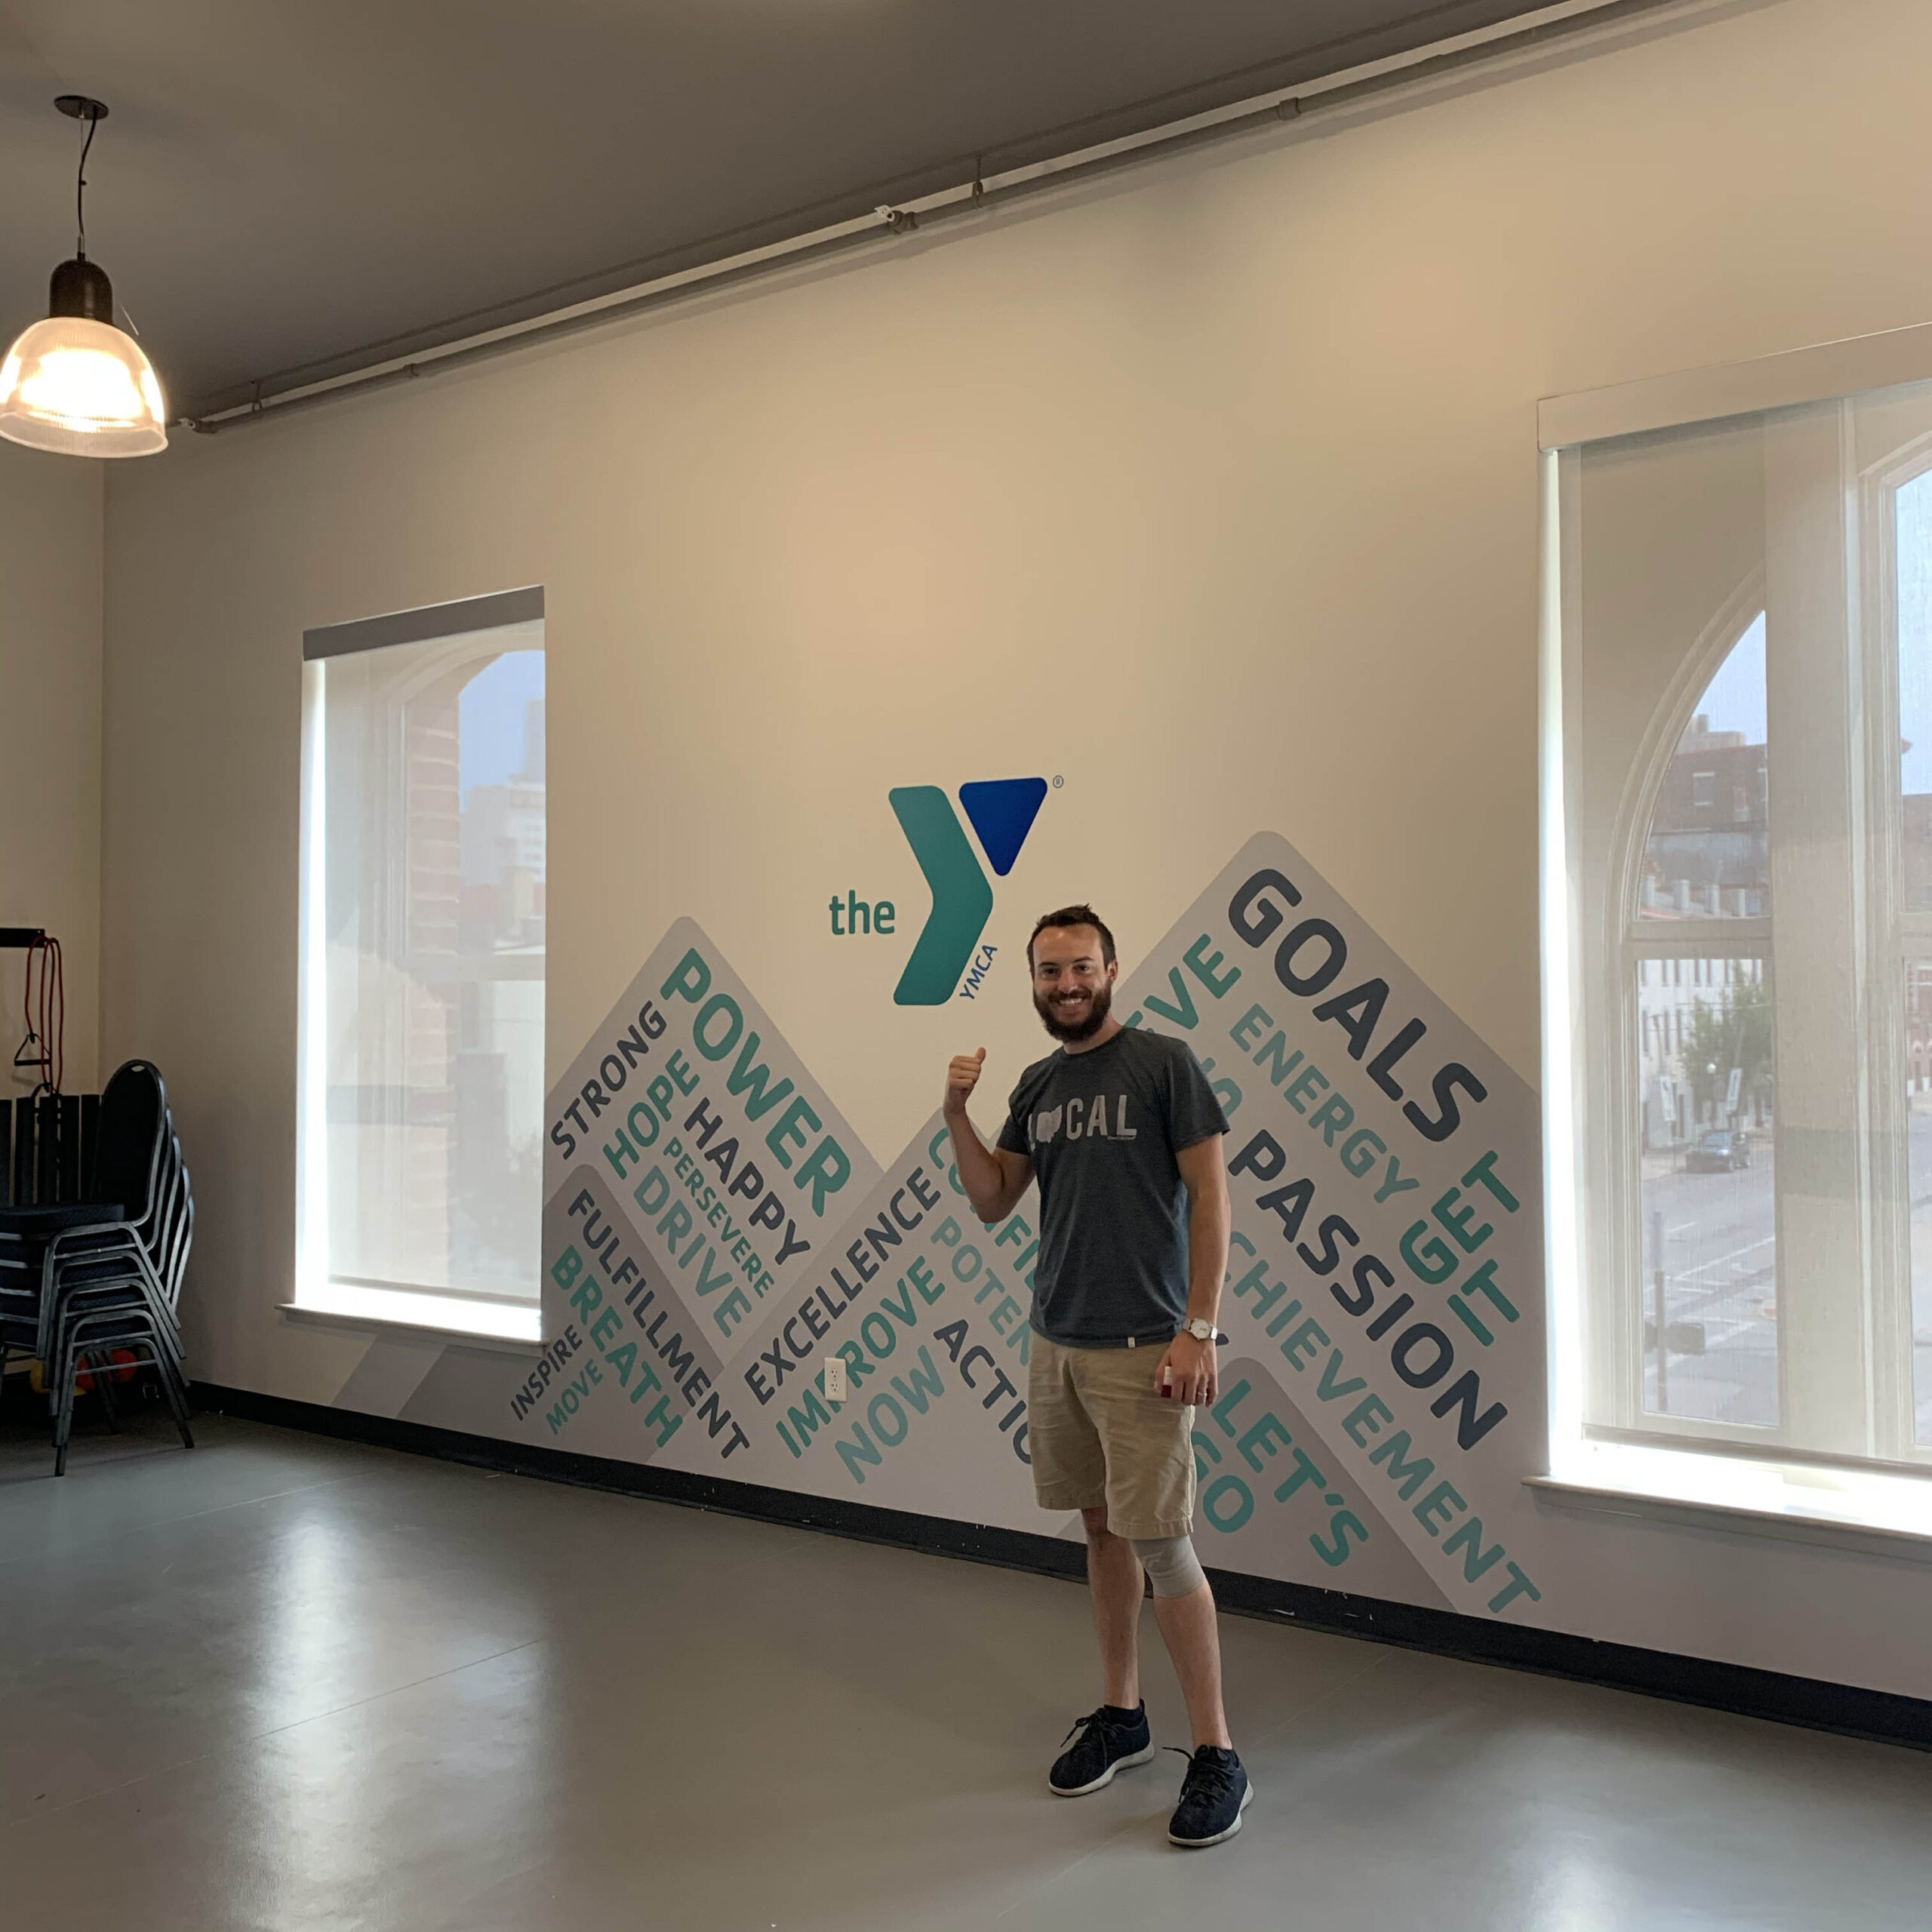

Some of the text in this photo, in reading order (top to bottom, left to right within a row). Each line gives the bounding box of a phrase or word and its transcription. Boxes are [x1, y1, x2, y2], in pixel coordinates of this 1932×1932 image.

[829, 890, 895, 935] the
[959, 944, 998, 1001] YMCA
[550, 1000, 667, 1160] STRONG
[660, 947, 851, 1217] POWER
[1228, 869, 1488, 1142] GOALS
[602, 1049, 700, 1180] HOPE
[684, 1097, 811, 1266] HAPPY
[1229, 1003, 1420, 1204] ENERGY
[633, 1164, 753, 1338] DRIVE
[663, 1137, 775, 1298] PERSEVERE
[743, 1166, 942, 1406] EXCELLENCE
[1228, 1129, 1509, 1451] PASSION
[1399, 1150, 1520, 1284] GET
[510, 1324, 583, 1421] INSPIRE
[550, 1244, 683, 1449] BREATH
[568, 1189, 750, 1459] FULFILLMENT
[1447, 1258, 1520, 1346] IT
[545, 1358, 604, 1435] MOVE
[834, 1344, 946, 1485] NOW
[1211, 1379, 1369, 1567] LET'S
